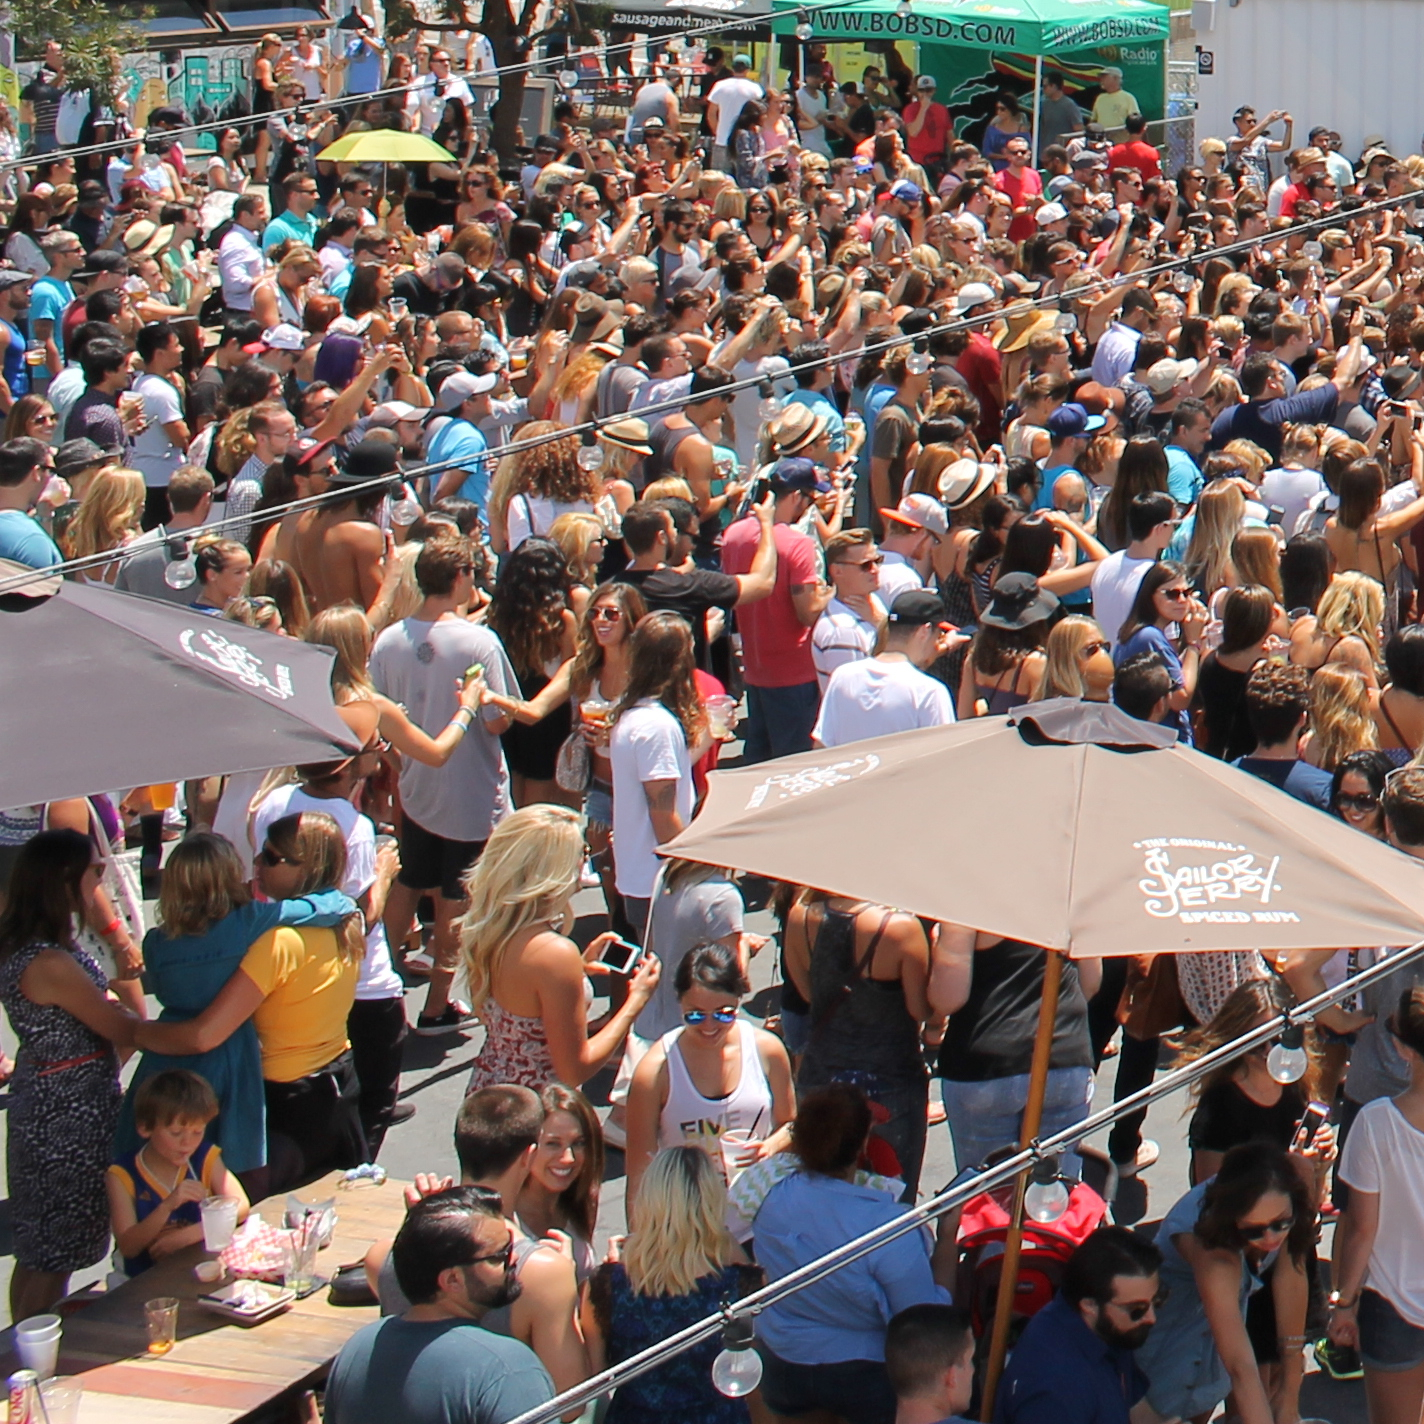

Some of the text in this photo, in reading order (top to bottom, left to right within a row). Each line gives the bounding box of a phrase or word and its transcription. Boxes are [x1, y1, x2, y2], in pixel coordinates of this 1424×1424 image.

[1119, 46, 1158, 60] Radio
[1141, 837, 1237, 852] THE ORIGINAL
[1139, 848, 1263, 897] SAILOR
[1179, 911, 1300, 924] SPICED RUM
[680, 1109, 743, 1139] FIVE
